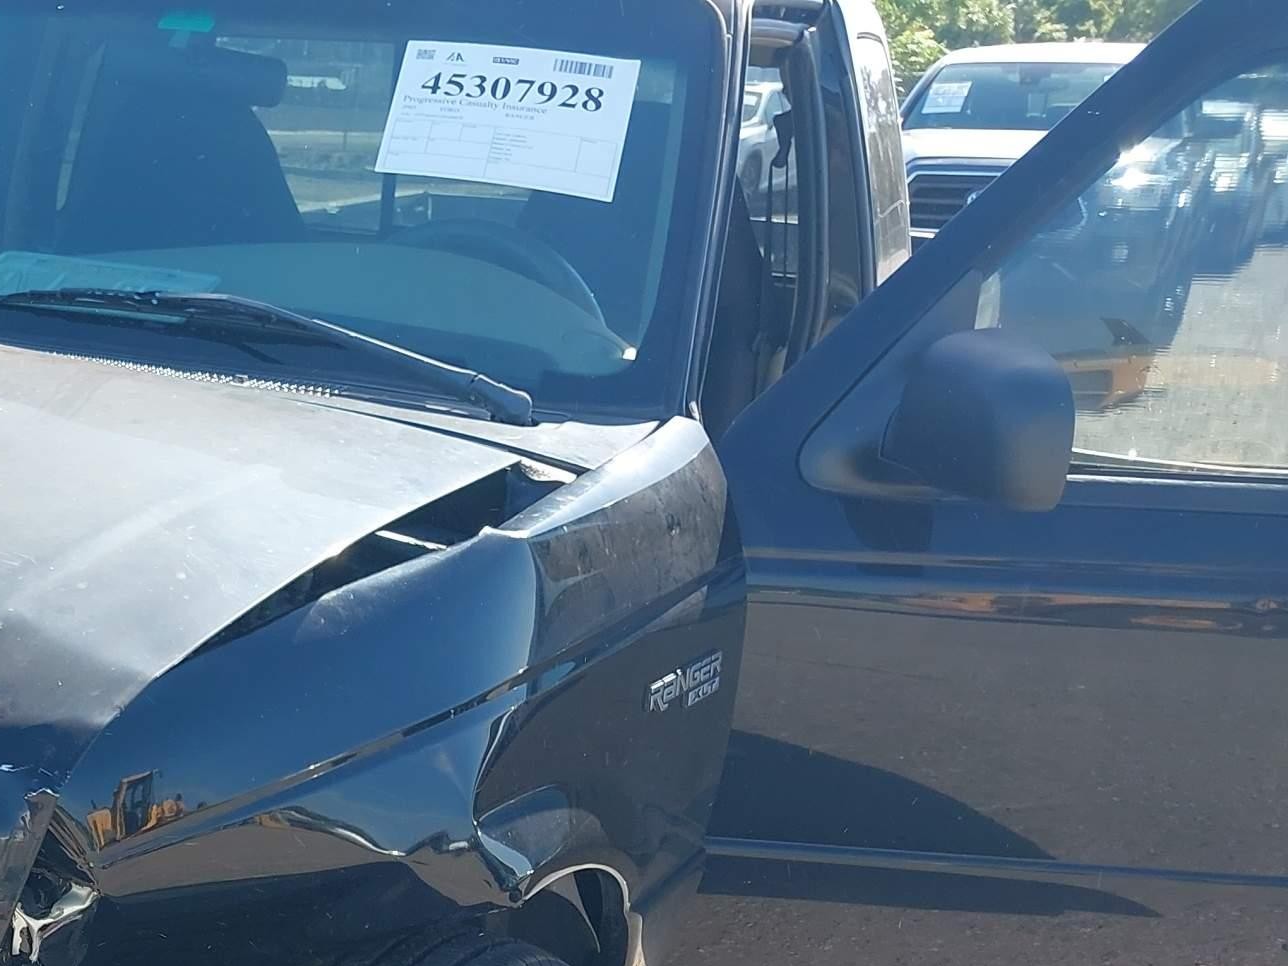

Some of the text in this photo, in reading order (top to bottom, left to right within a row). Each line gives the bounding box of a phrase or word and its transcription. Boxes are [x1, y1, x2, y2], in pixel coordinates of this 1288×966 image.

[402, 94, 458, 106] Progressive
[459, 98, 499, 111] Casualty
[502, 102, 548, 114] Insurance
[421, 71, 604, 112] 45307928
